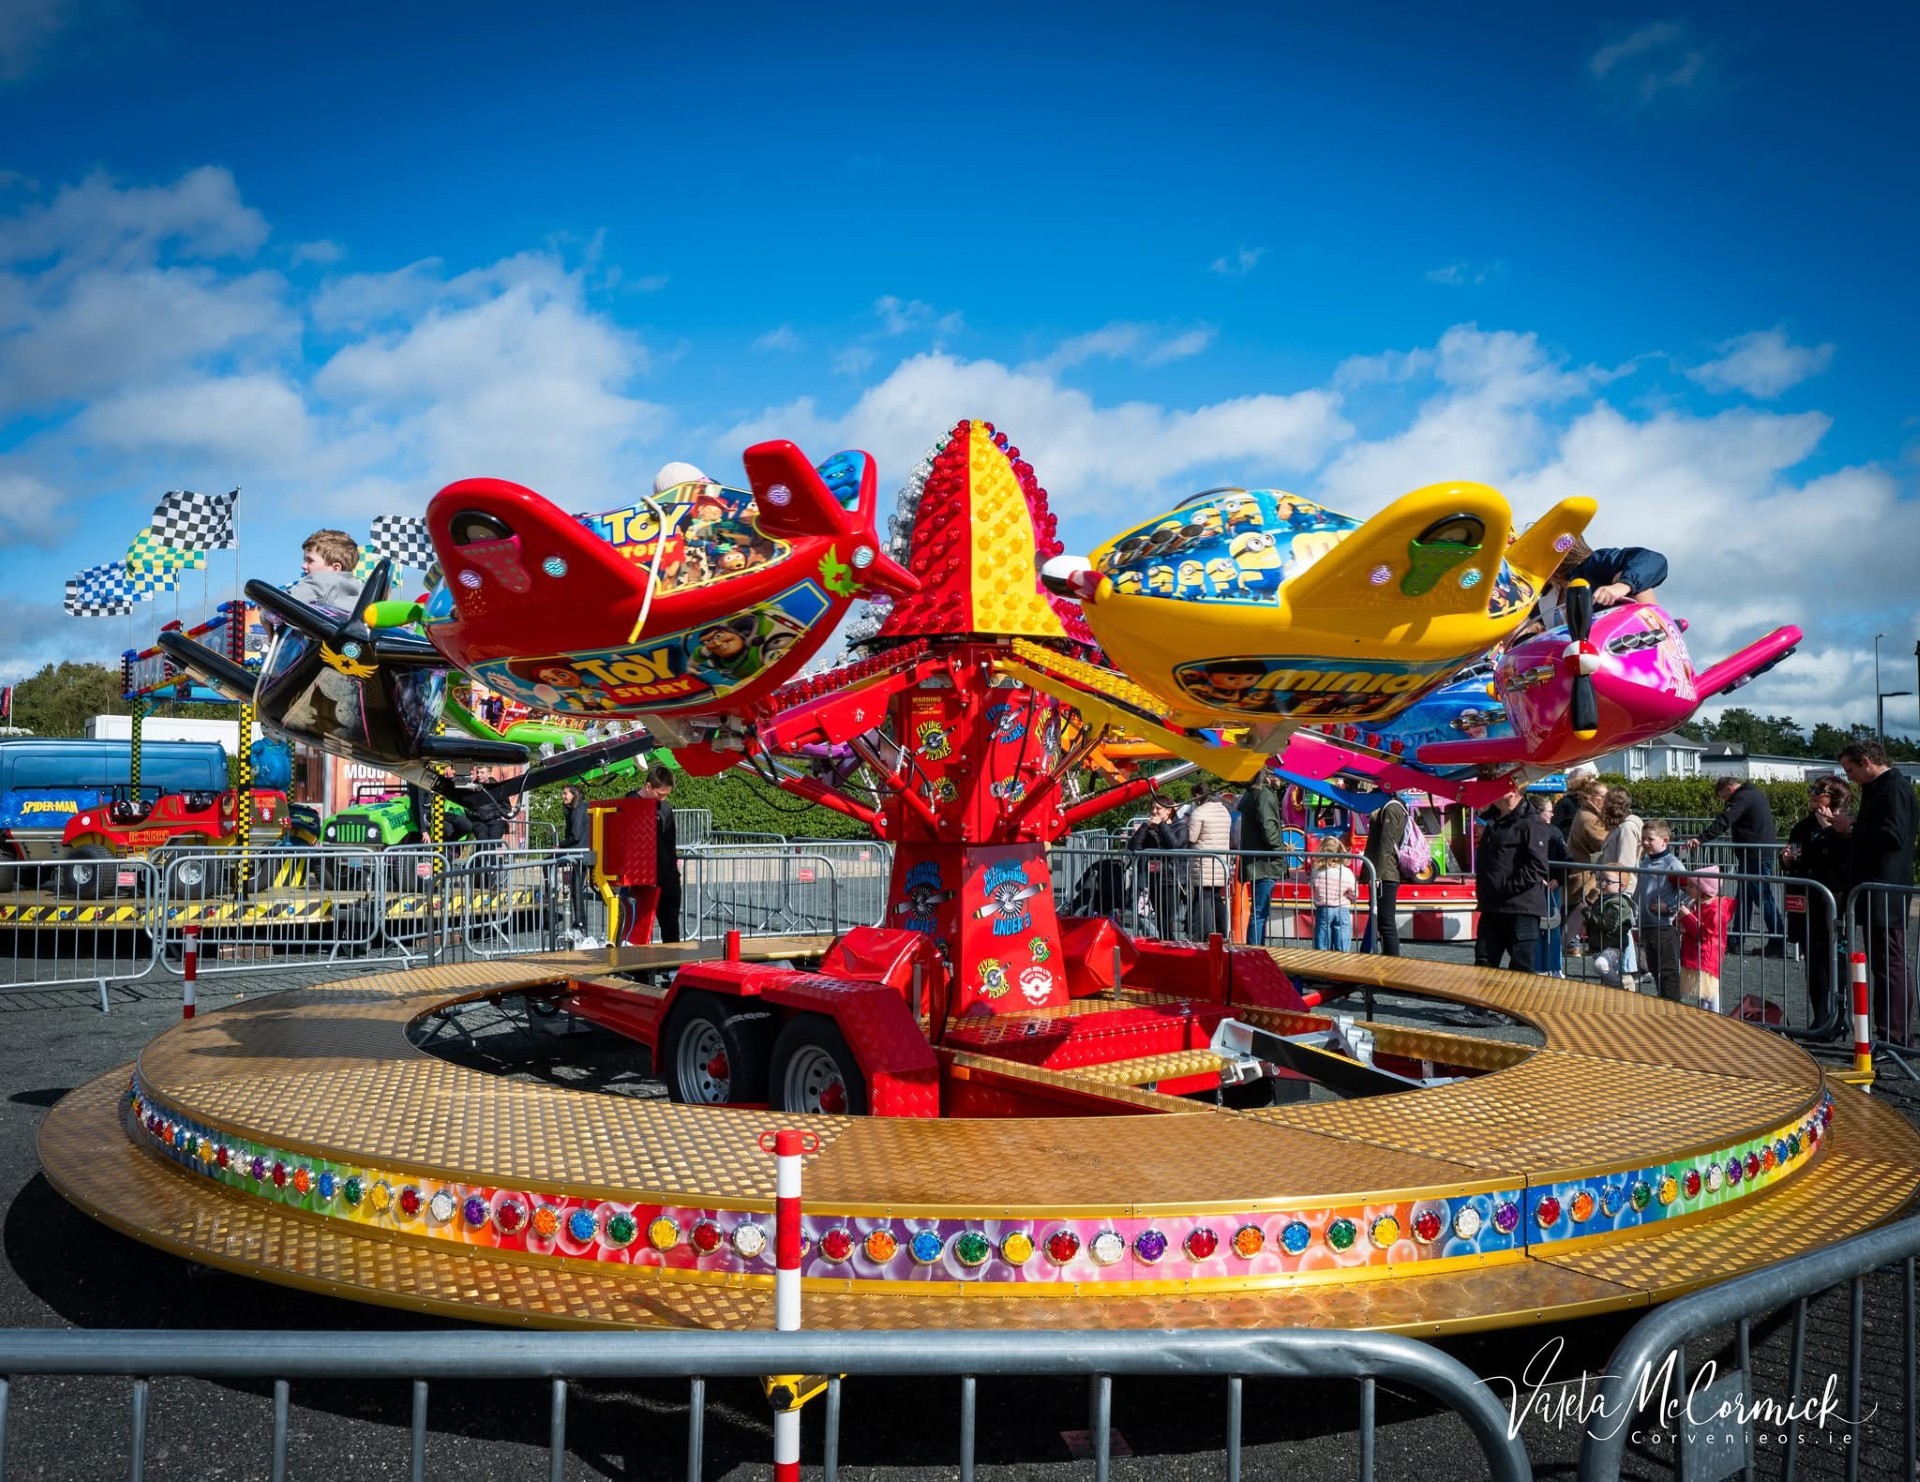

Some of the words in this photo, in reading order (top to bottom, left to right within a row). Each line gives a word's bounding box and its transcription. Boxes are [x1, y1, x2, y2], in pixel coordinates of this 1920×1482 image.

[603, 503, 692, 544] TOY
[570, 648, 676, 686] TOY
[614, 680, 691, 698] STORY
[926, 743, 952, 761] PLANES
[20, 801, 79, 814] SPIDER-MAN
[993, 917, 1024, 936] UNDER
[1024, 912, 1032, 928] 3
[988, 981, 1010, 999] PLANES
